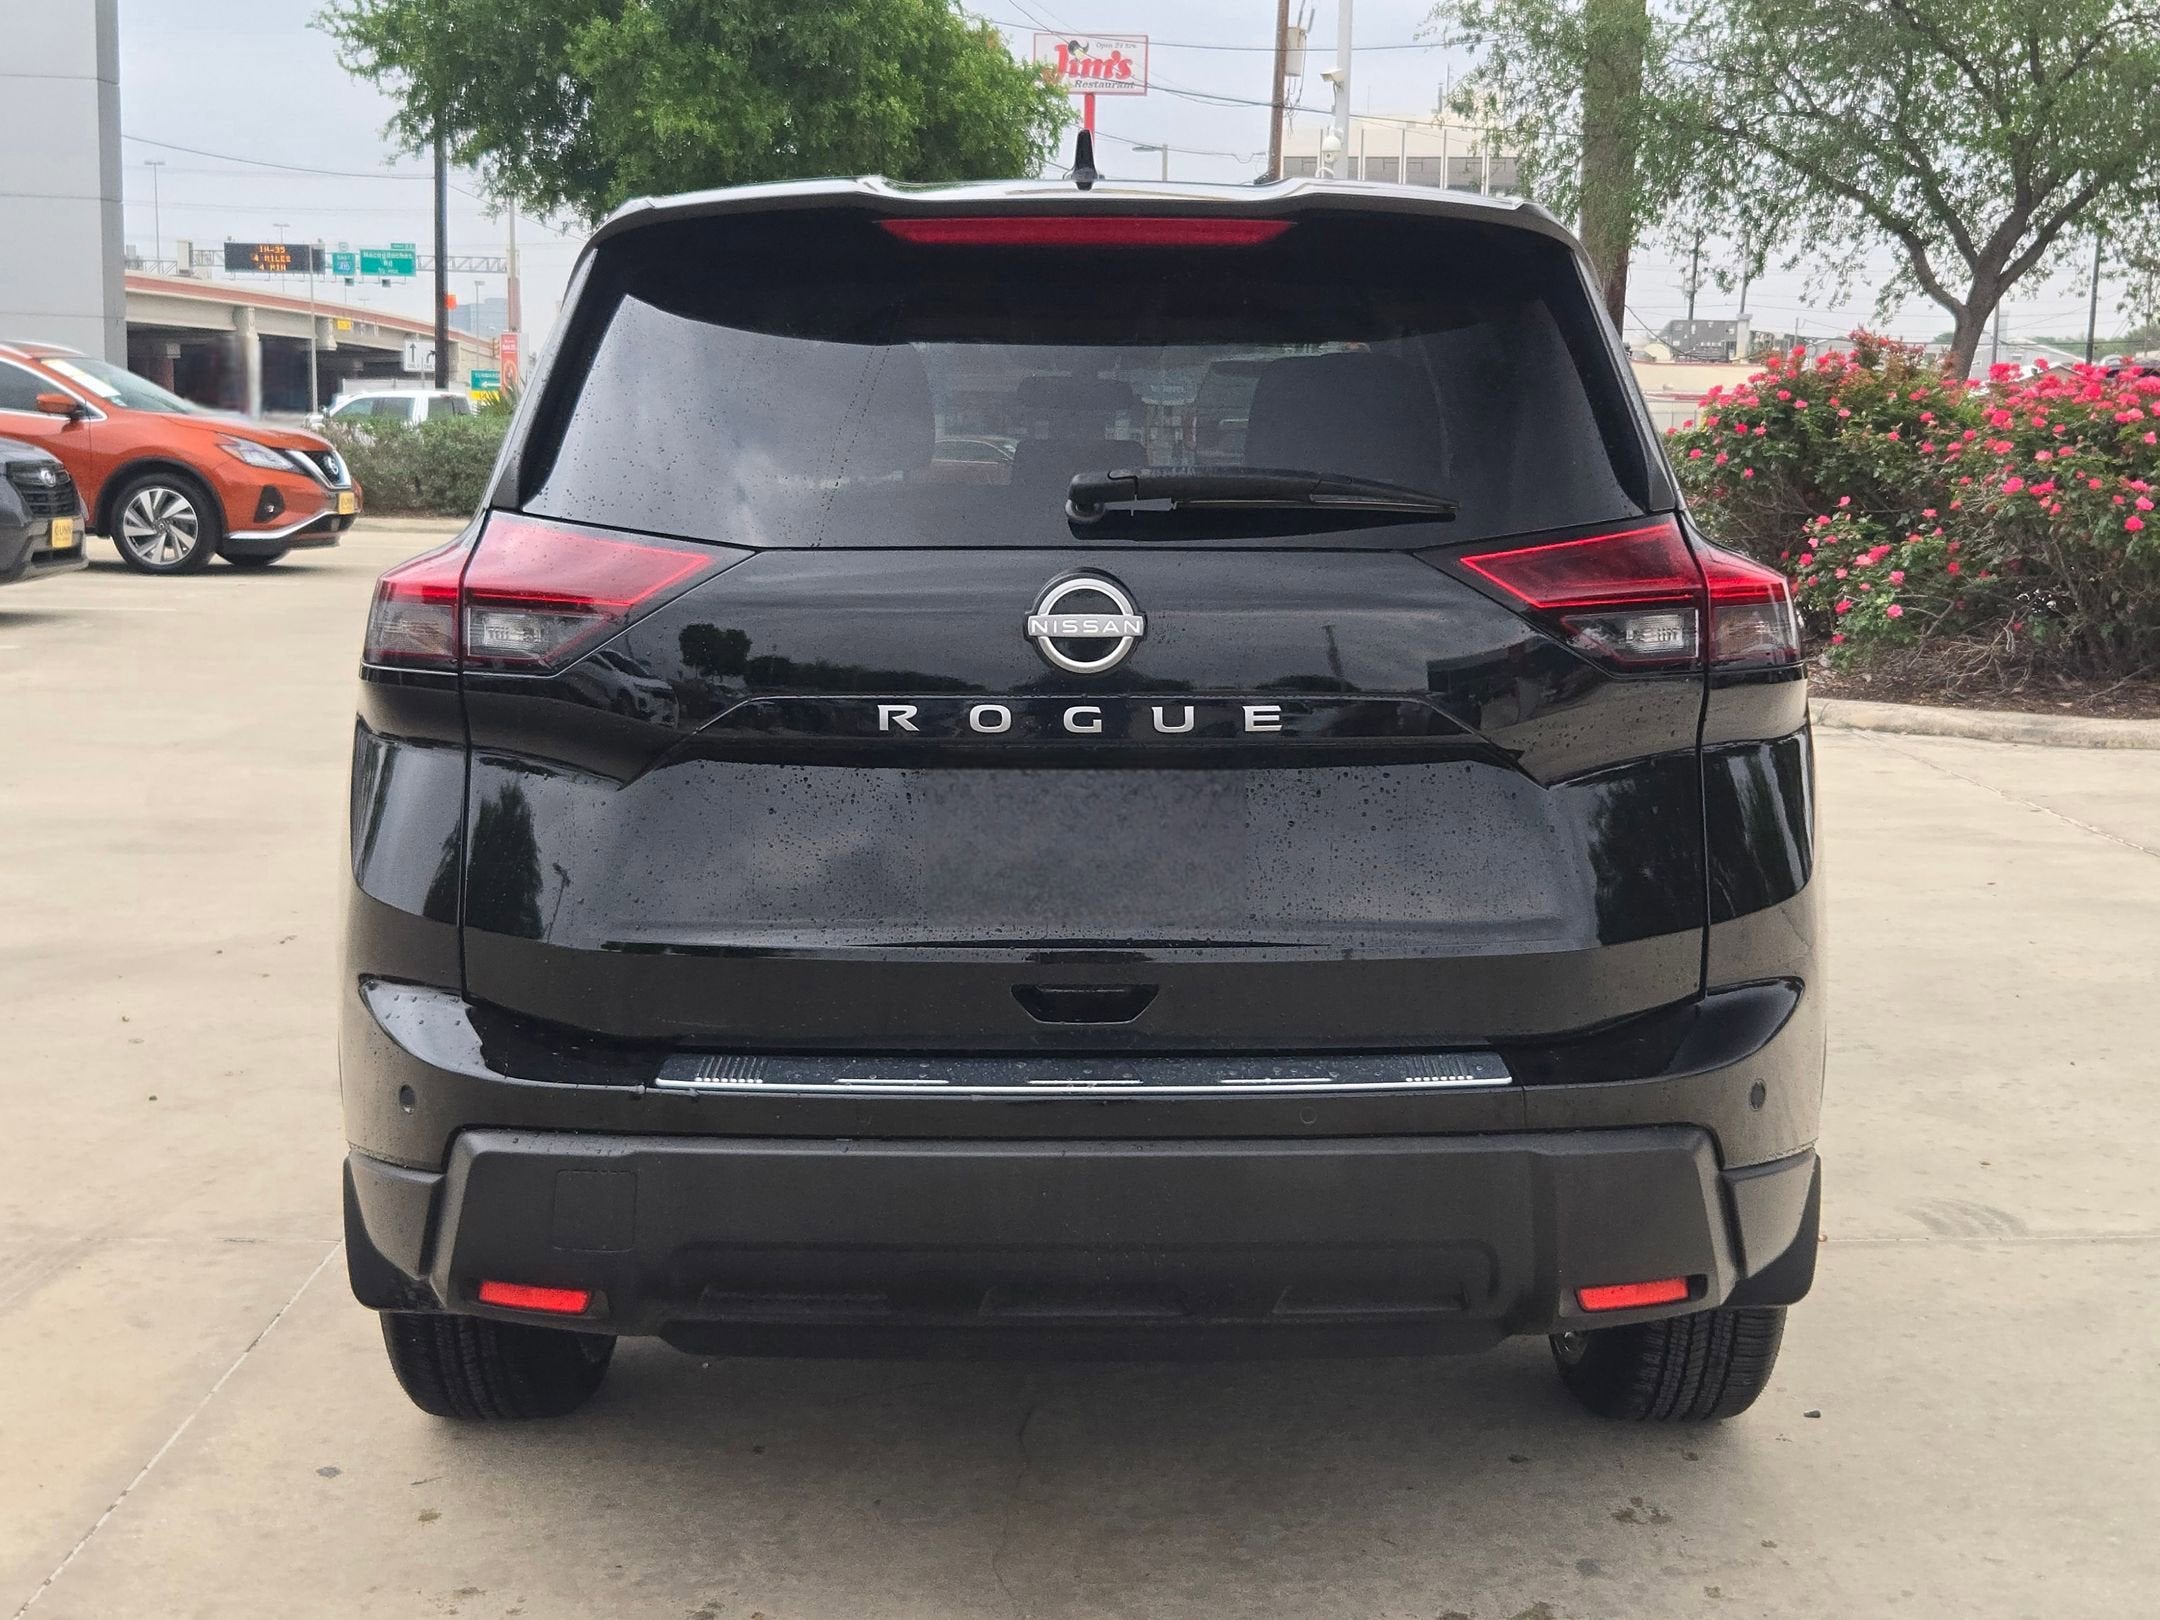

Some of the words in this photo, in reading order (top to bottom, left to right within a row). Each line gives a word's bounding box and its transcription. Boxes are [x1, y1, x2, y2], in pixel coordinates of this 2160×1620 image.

[1054, 43, 1132, 80] Jim's
[1074, 80, 1135, 89] Restaurant
[1031, 620, 1140, 634] NISSAN
[877, 704, 1283, 733] ROGUE
